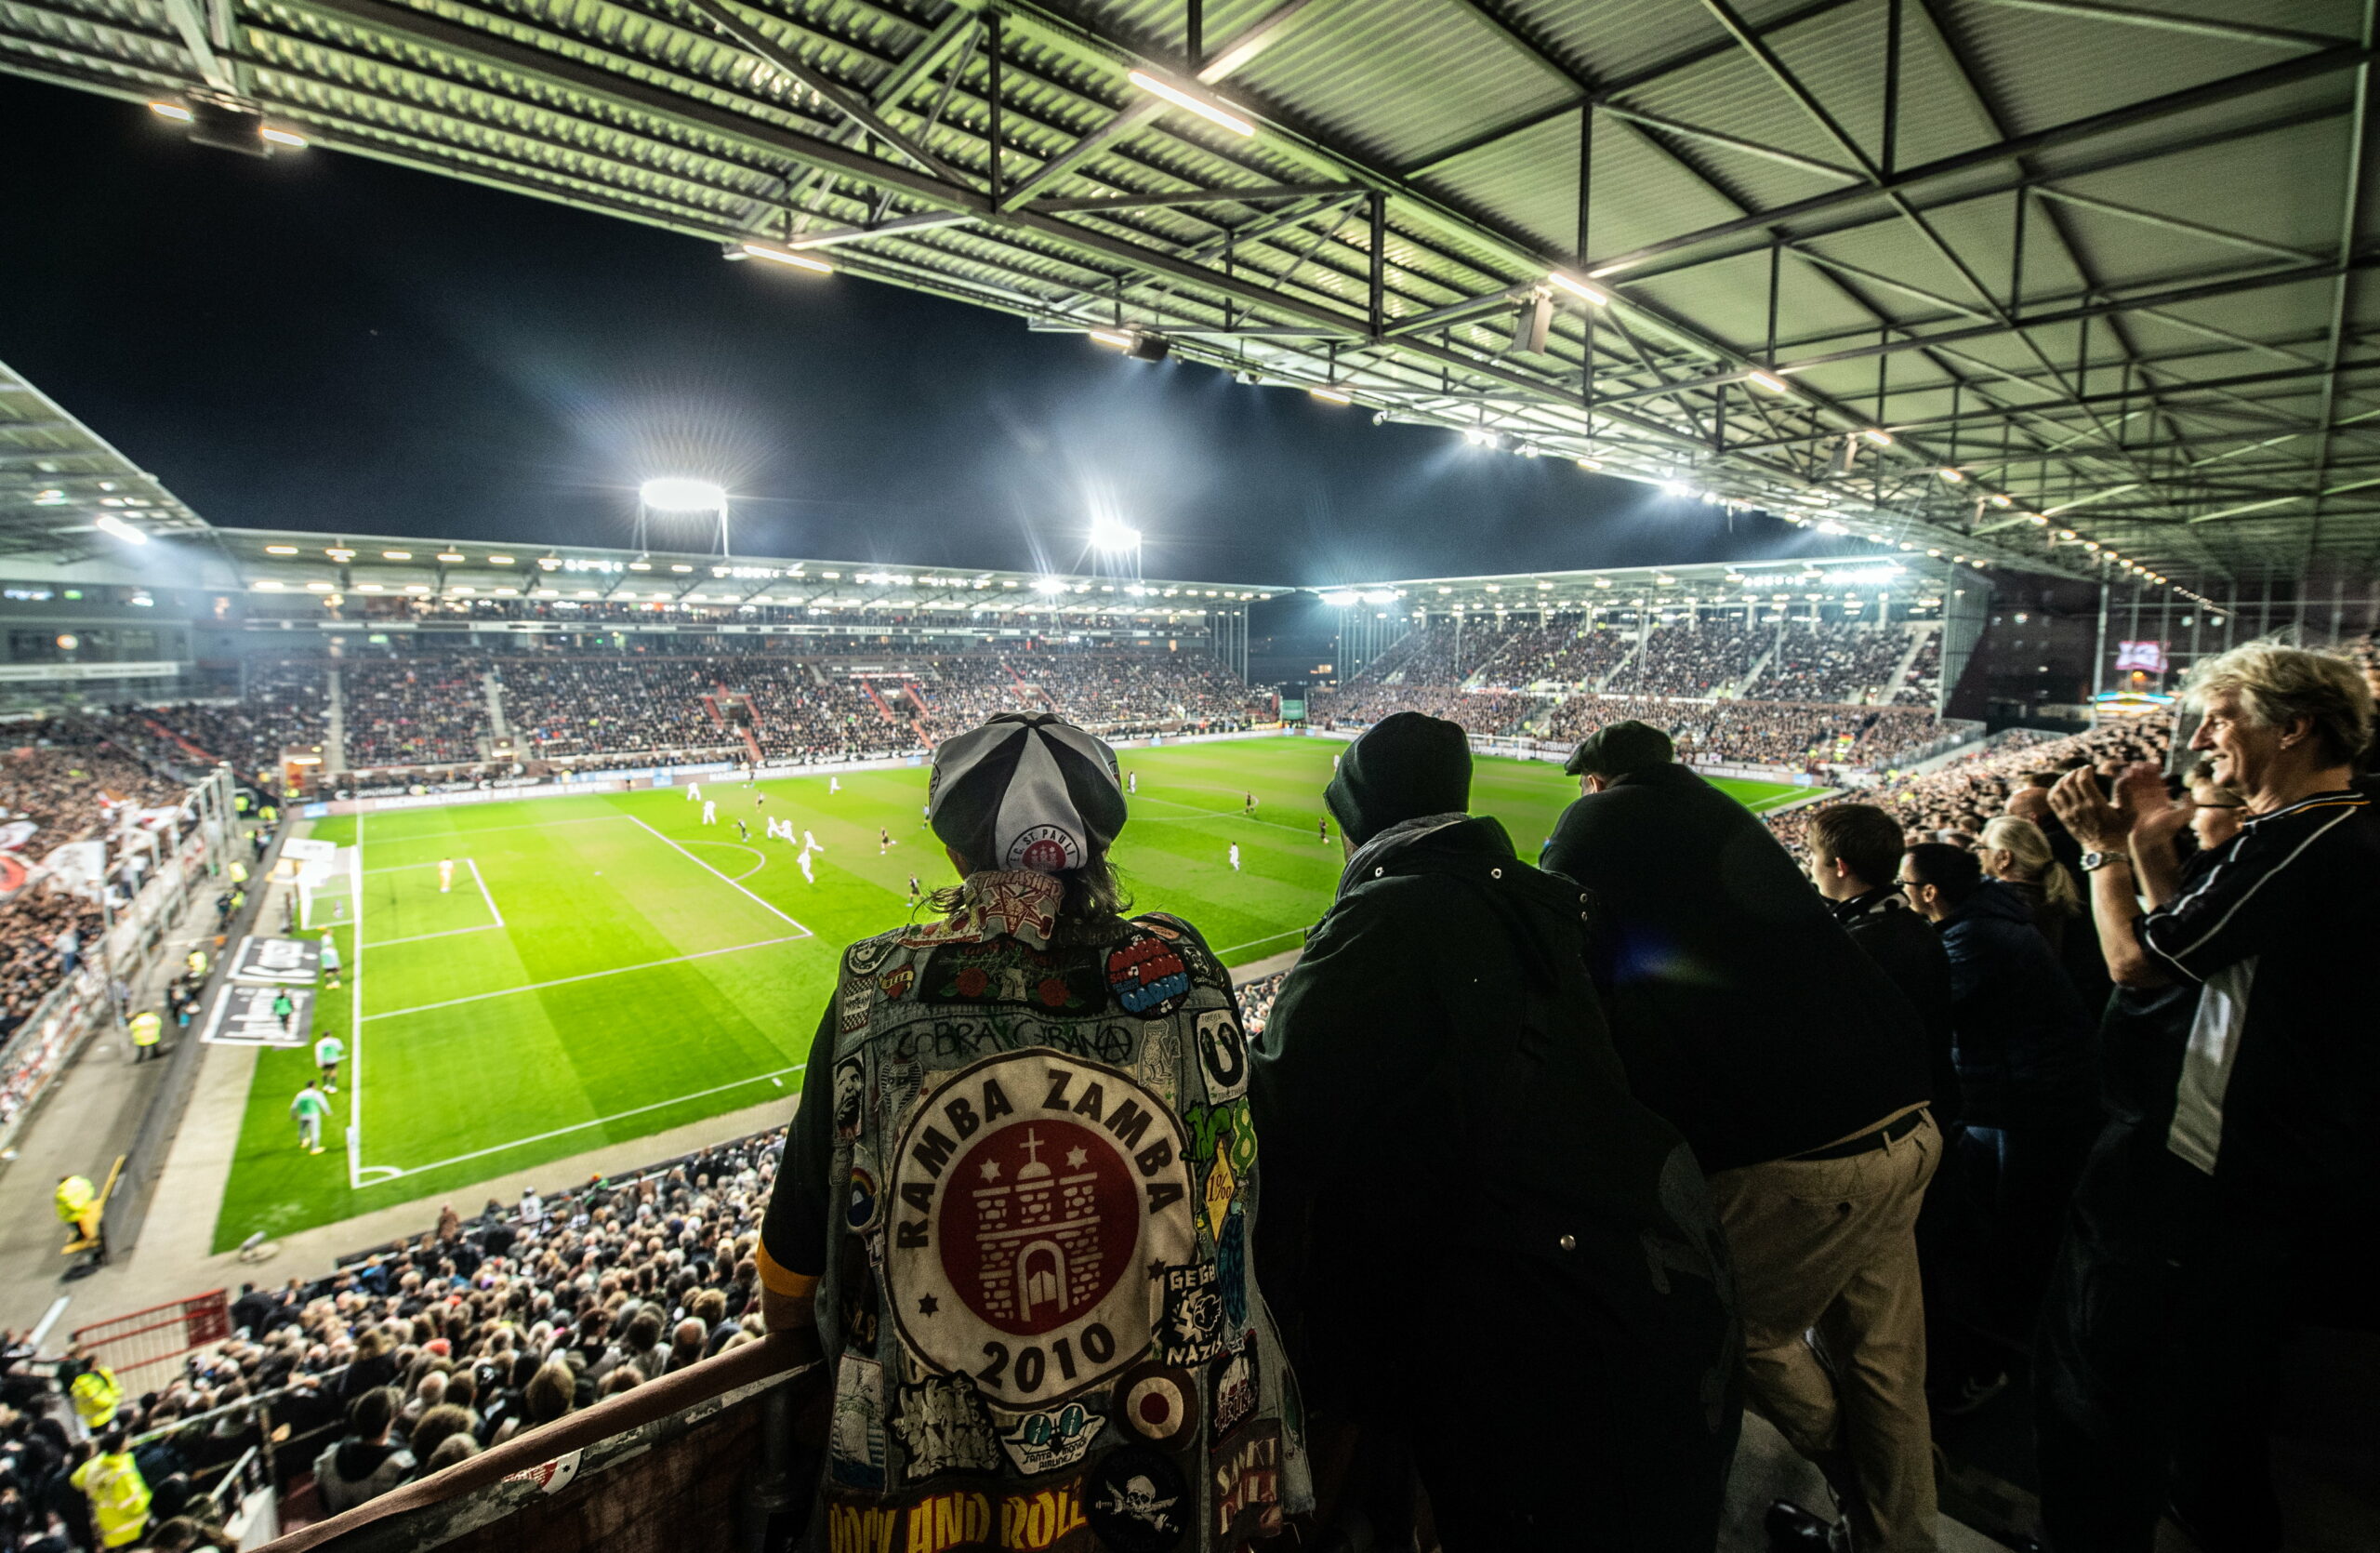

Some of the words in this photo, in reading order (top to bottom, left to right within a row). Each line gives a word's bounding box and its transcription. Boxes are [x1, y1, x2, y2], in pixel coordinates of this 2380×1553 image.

[1024, 831, 1038, 846] ST.
[1042, 829, 1077, 856] PAULI
[975, 870, 1064, 903] THRASHER
[898, 1021, 1002, 1059] COBRA
[896, 1078, 1014, 1249] RAMBA
[1041, 1068, 1185, 1215] ZAMBA
[975, 1322, 1116, 1393] 2010
[1023, 1453, 1051, 1465] SANTA
[908, 1492, 991, 1552] AND
[1000, 1490, 1088, 1550] ROLL
